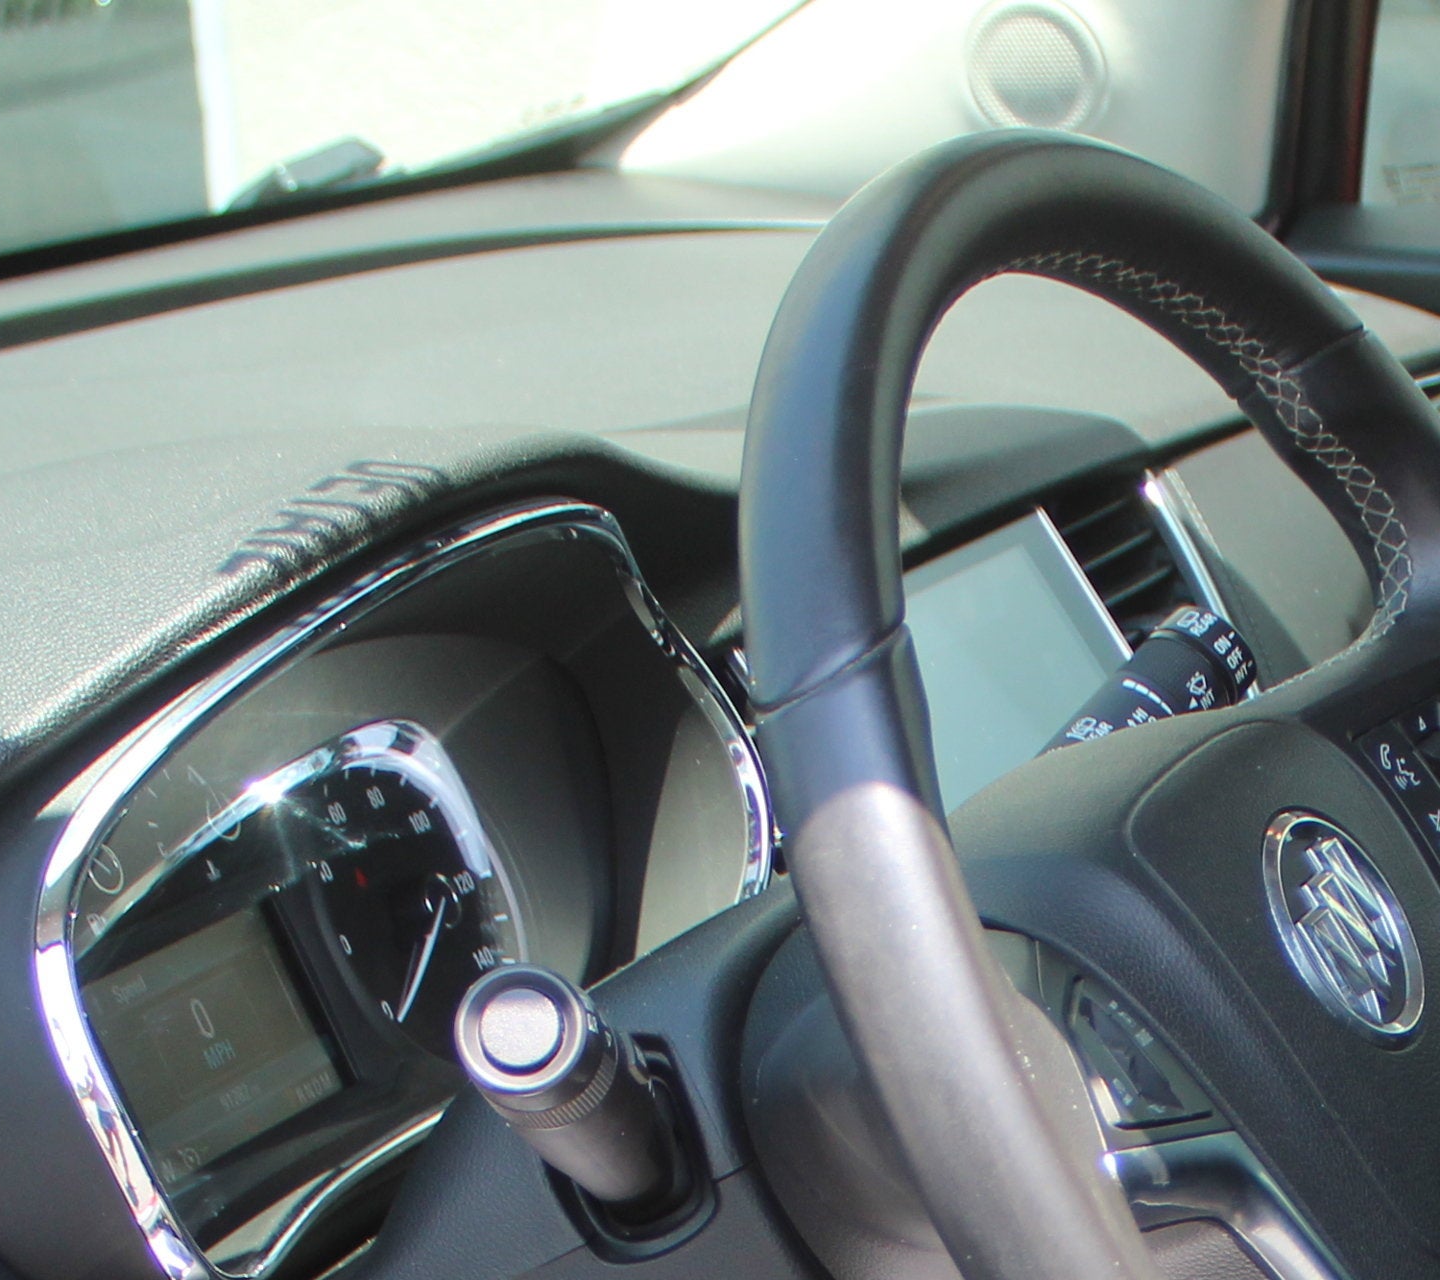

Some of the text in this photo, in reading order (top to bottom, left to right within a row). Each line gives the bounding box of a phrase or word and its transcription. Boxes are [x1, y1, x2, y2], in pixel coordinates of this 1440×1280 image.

[1190, 612, 1218, 637] REAR
[1213, 635, 1232, 655] ON
[1227, 646, 1244, 669] OFF
[1235, 666, 1249, 684] INT
[1200, 689, 1216, 710] INT
[1084, 721, 1114, 742] EAR
[366, 786, 386, 809] 80
[327, 802, 347, 825] 60
[408, 810, 432, 834] 100
[453, 870, 476, 895] 120
[472, 946, 495, 970] 140
[190, 999, 214, 1038] 0
[203, 1038, 237, 1071] MPH
